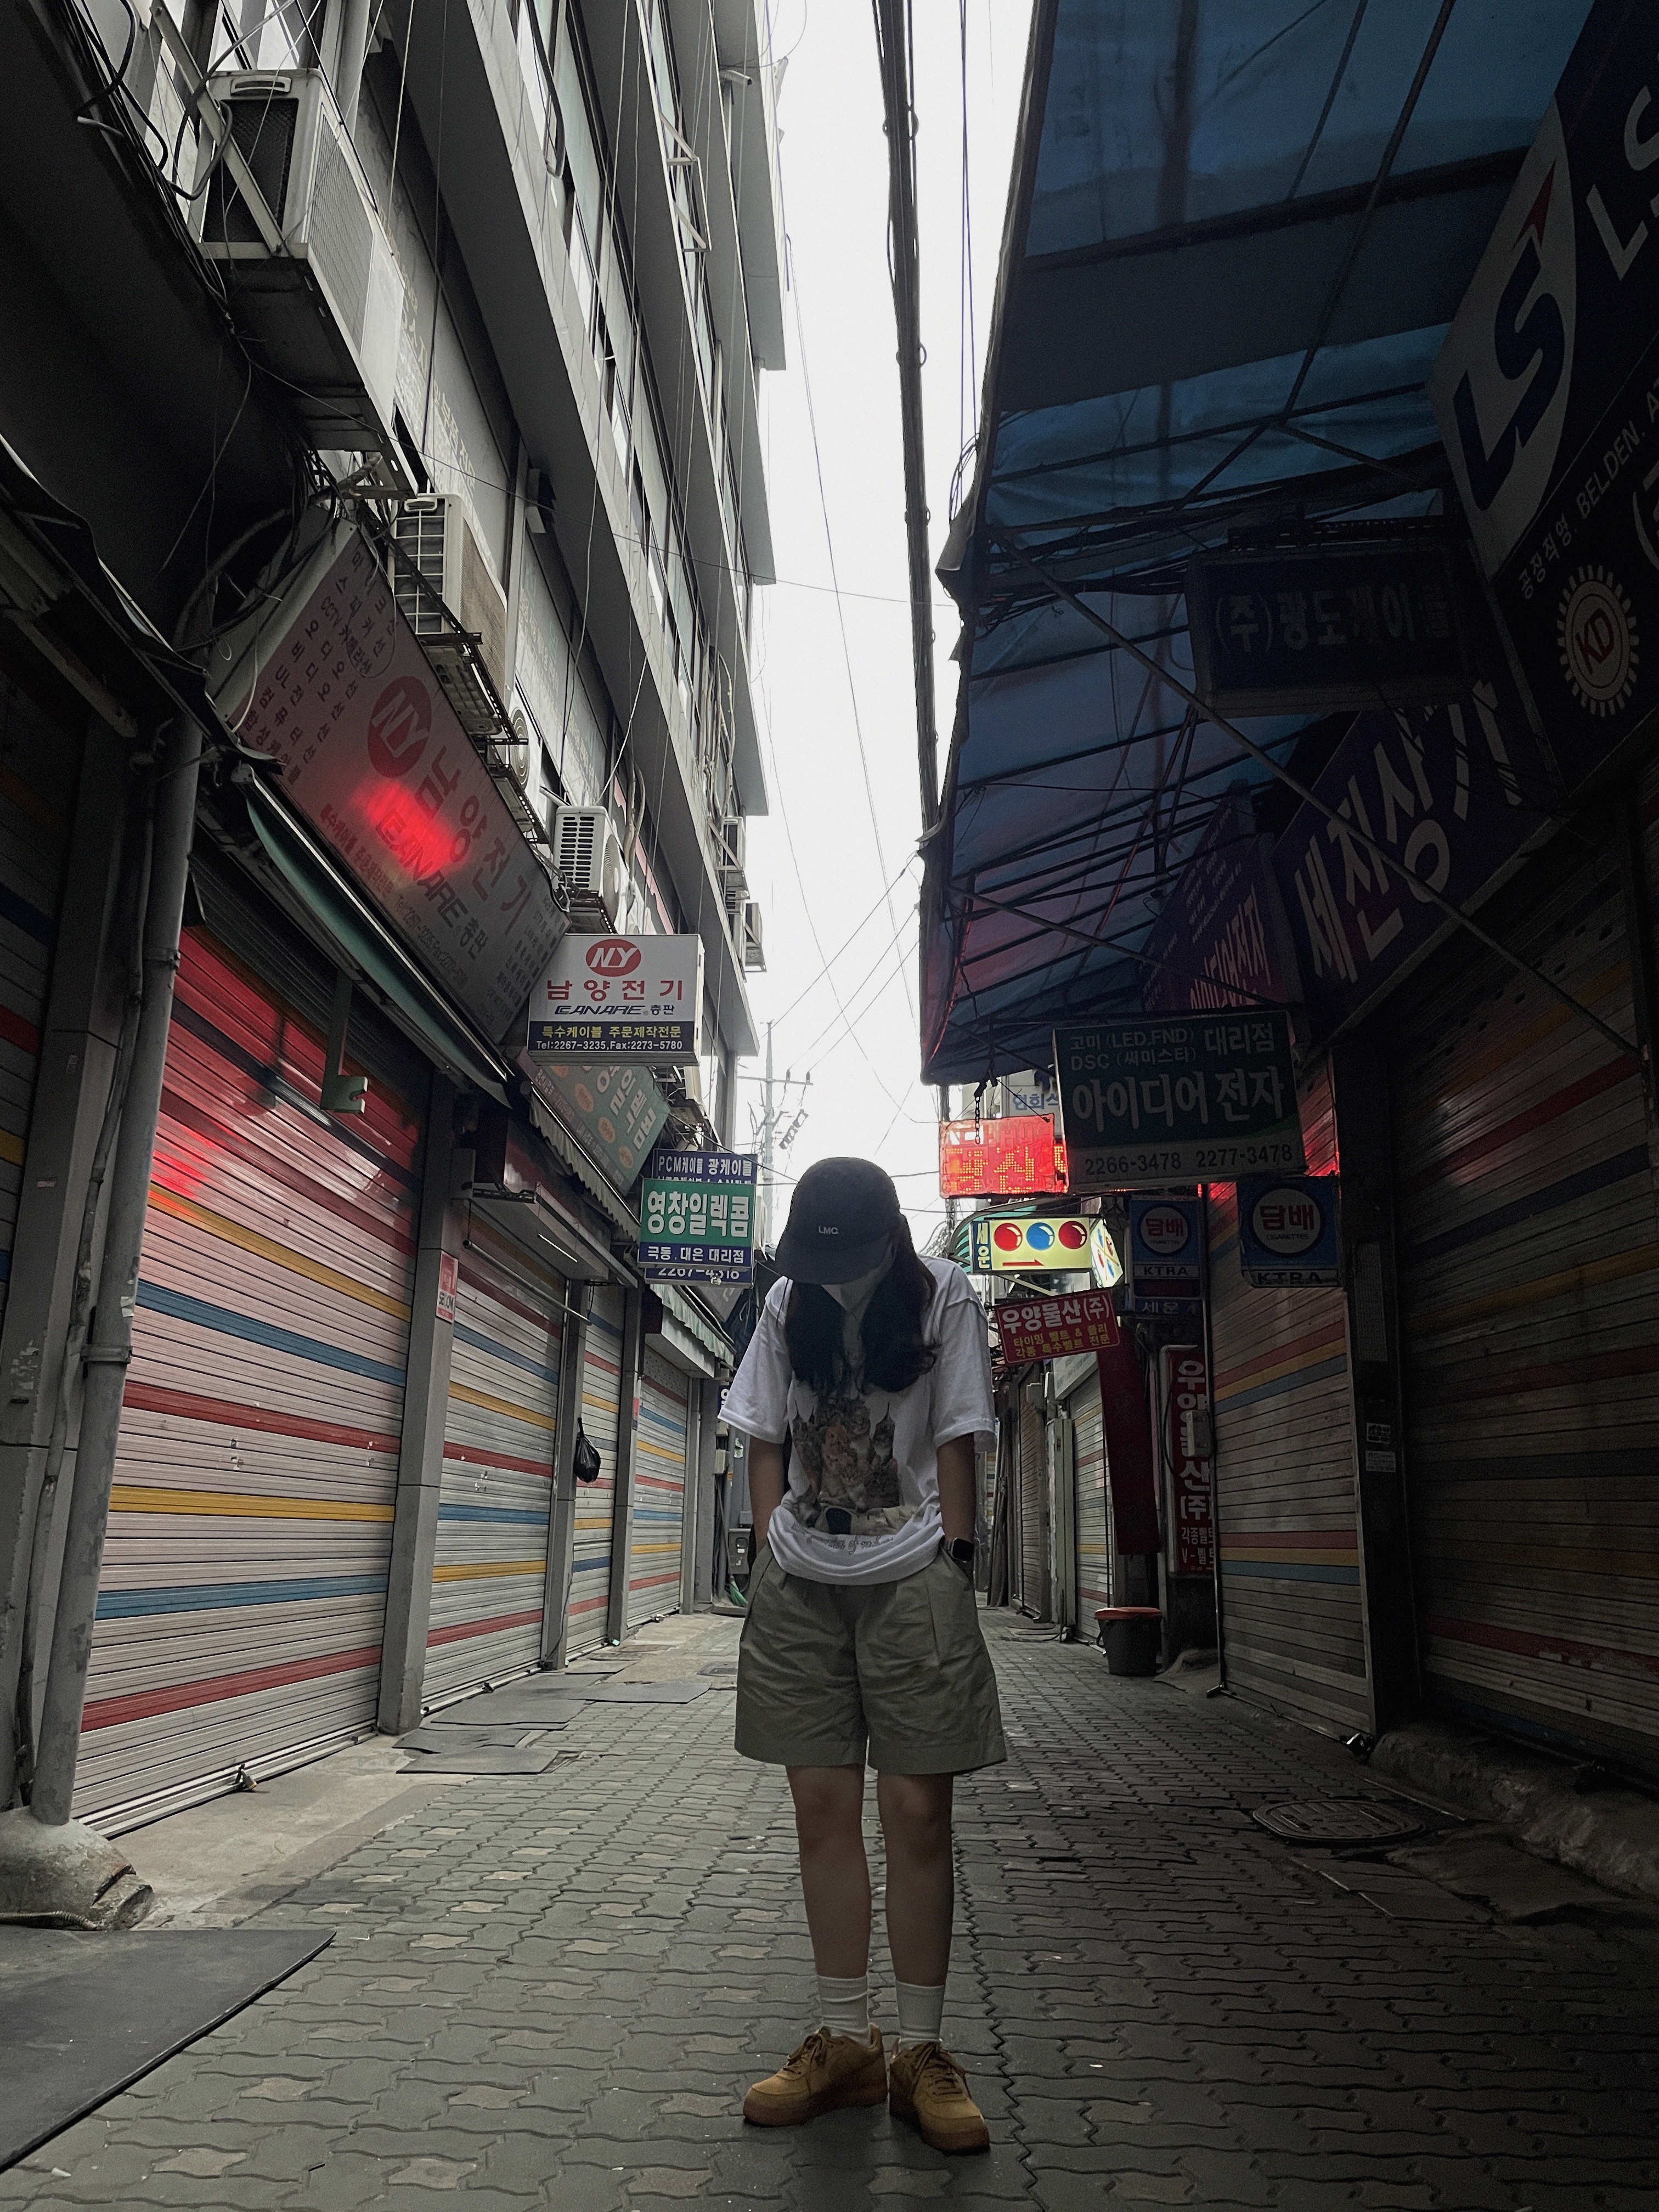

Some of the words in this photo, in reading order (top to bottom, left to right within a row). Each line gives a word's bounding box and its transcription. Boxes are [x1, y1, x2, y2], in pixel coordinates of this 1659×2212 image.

[1575, 608, 1614, 675] KD
[410, 742, 533, 938] 남양전기
[589, 947, 639, 968] NY
[547, 980, 682, 1001] 남양전기
[650, 1005, 675, 1015] 총판
[542, 1026, 602, 1038] 특수케이블
[610, 1026, 681, 1038] 주문제작전문
[1204, 1023, 1274, 1055] 대리점
[1071, 1054, 1109, 1070] DSC
[1073, 1071, 1208, 1133] 아이디어
[1215, 1065, 1284, 1122] 전자
[658, 1156, 703, 1174] PCM케이블
[708, 1159, 752, 1176] 광케이블
[1085, 1152, 1182, 1175] 2266-3478
[1197, 1144, 1292, 1168] 2277-3478
[647, 1191, 749, 1237] 영창일렉콤
[1260, 1204, 1314, 1231] 담배
[1146, 1218, 1184, 1237] 담배
[680, 1248, 703, 1261] 대은
[709, 1249, 744, 1263] 대리점
[977, 1222, 990, 1269] 세운
[1144, 1267, 1188, 1276] KTRA
[1015, 1346, 1036, 1358] 각종
[1090, 1334, 1110, 1346] 전문
